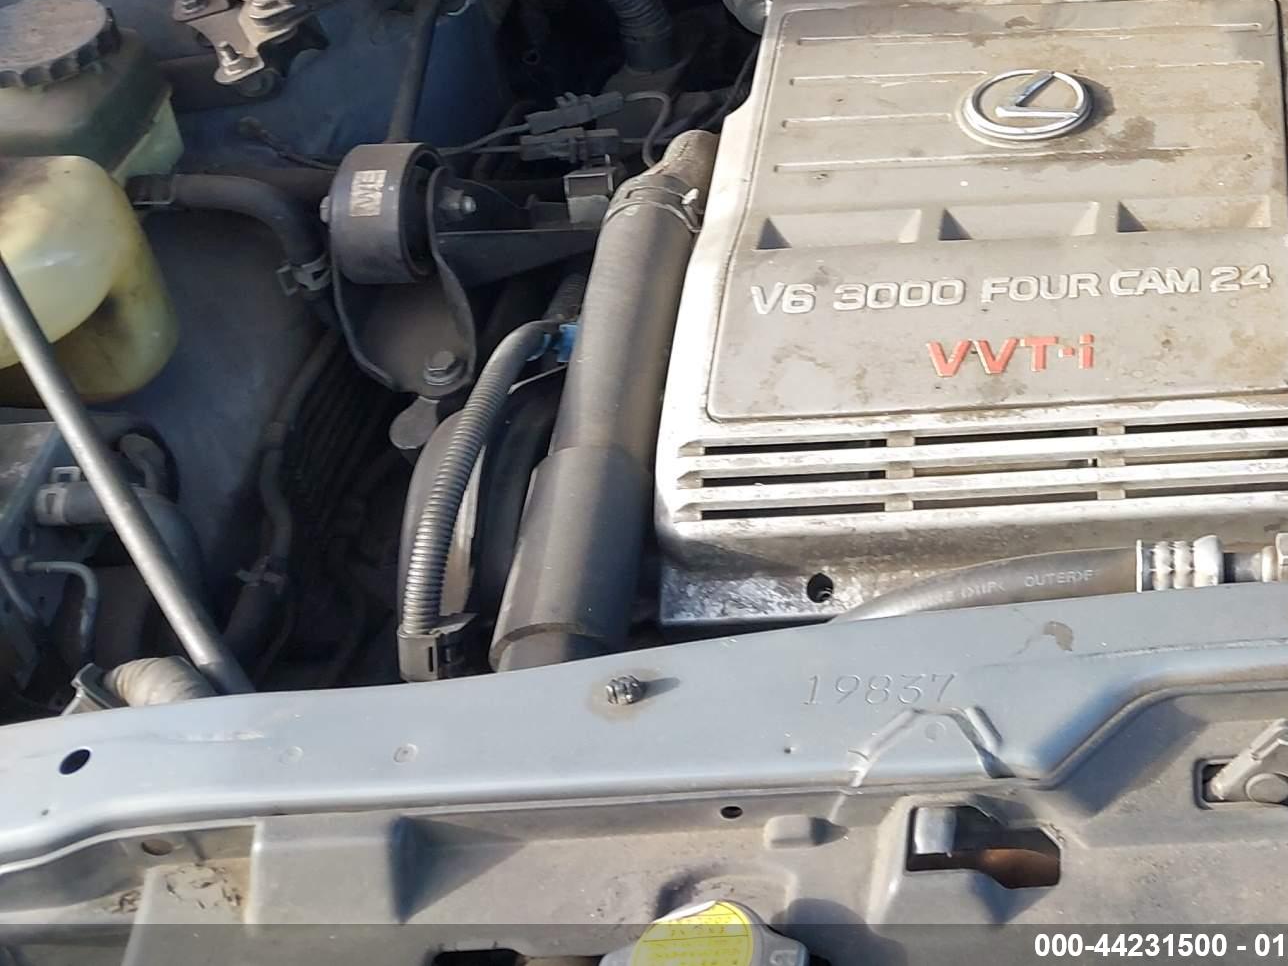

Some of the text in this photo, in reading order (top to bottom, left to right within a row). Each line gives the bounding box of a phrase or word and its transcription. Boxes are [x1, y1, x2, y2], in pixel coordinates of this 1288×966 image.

[751, 264, 1273, 314] V6 3000 FOUR CAM 24
[802, 671, 958, 706] 19837
